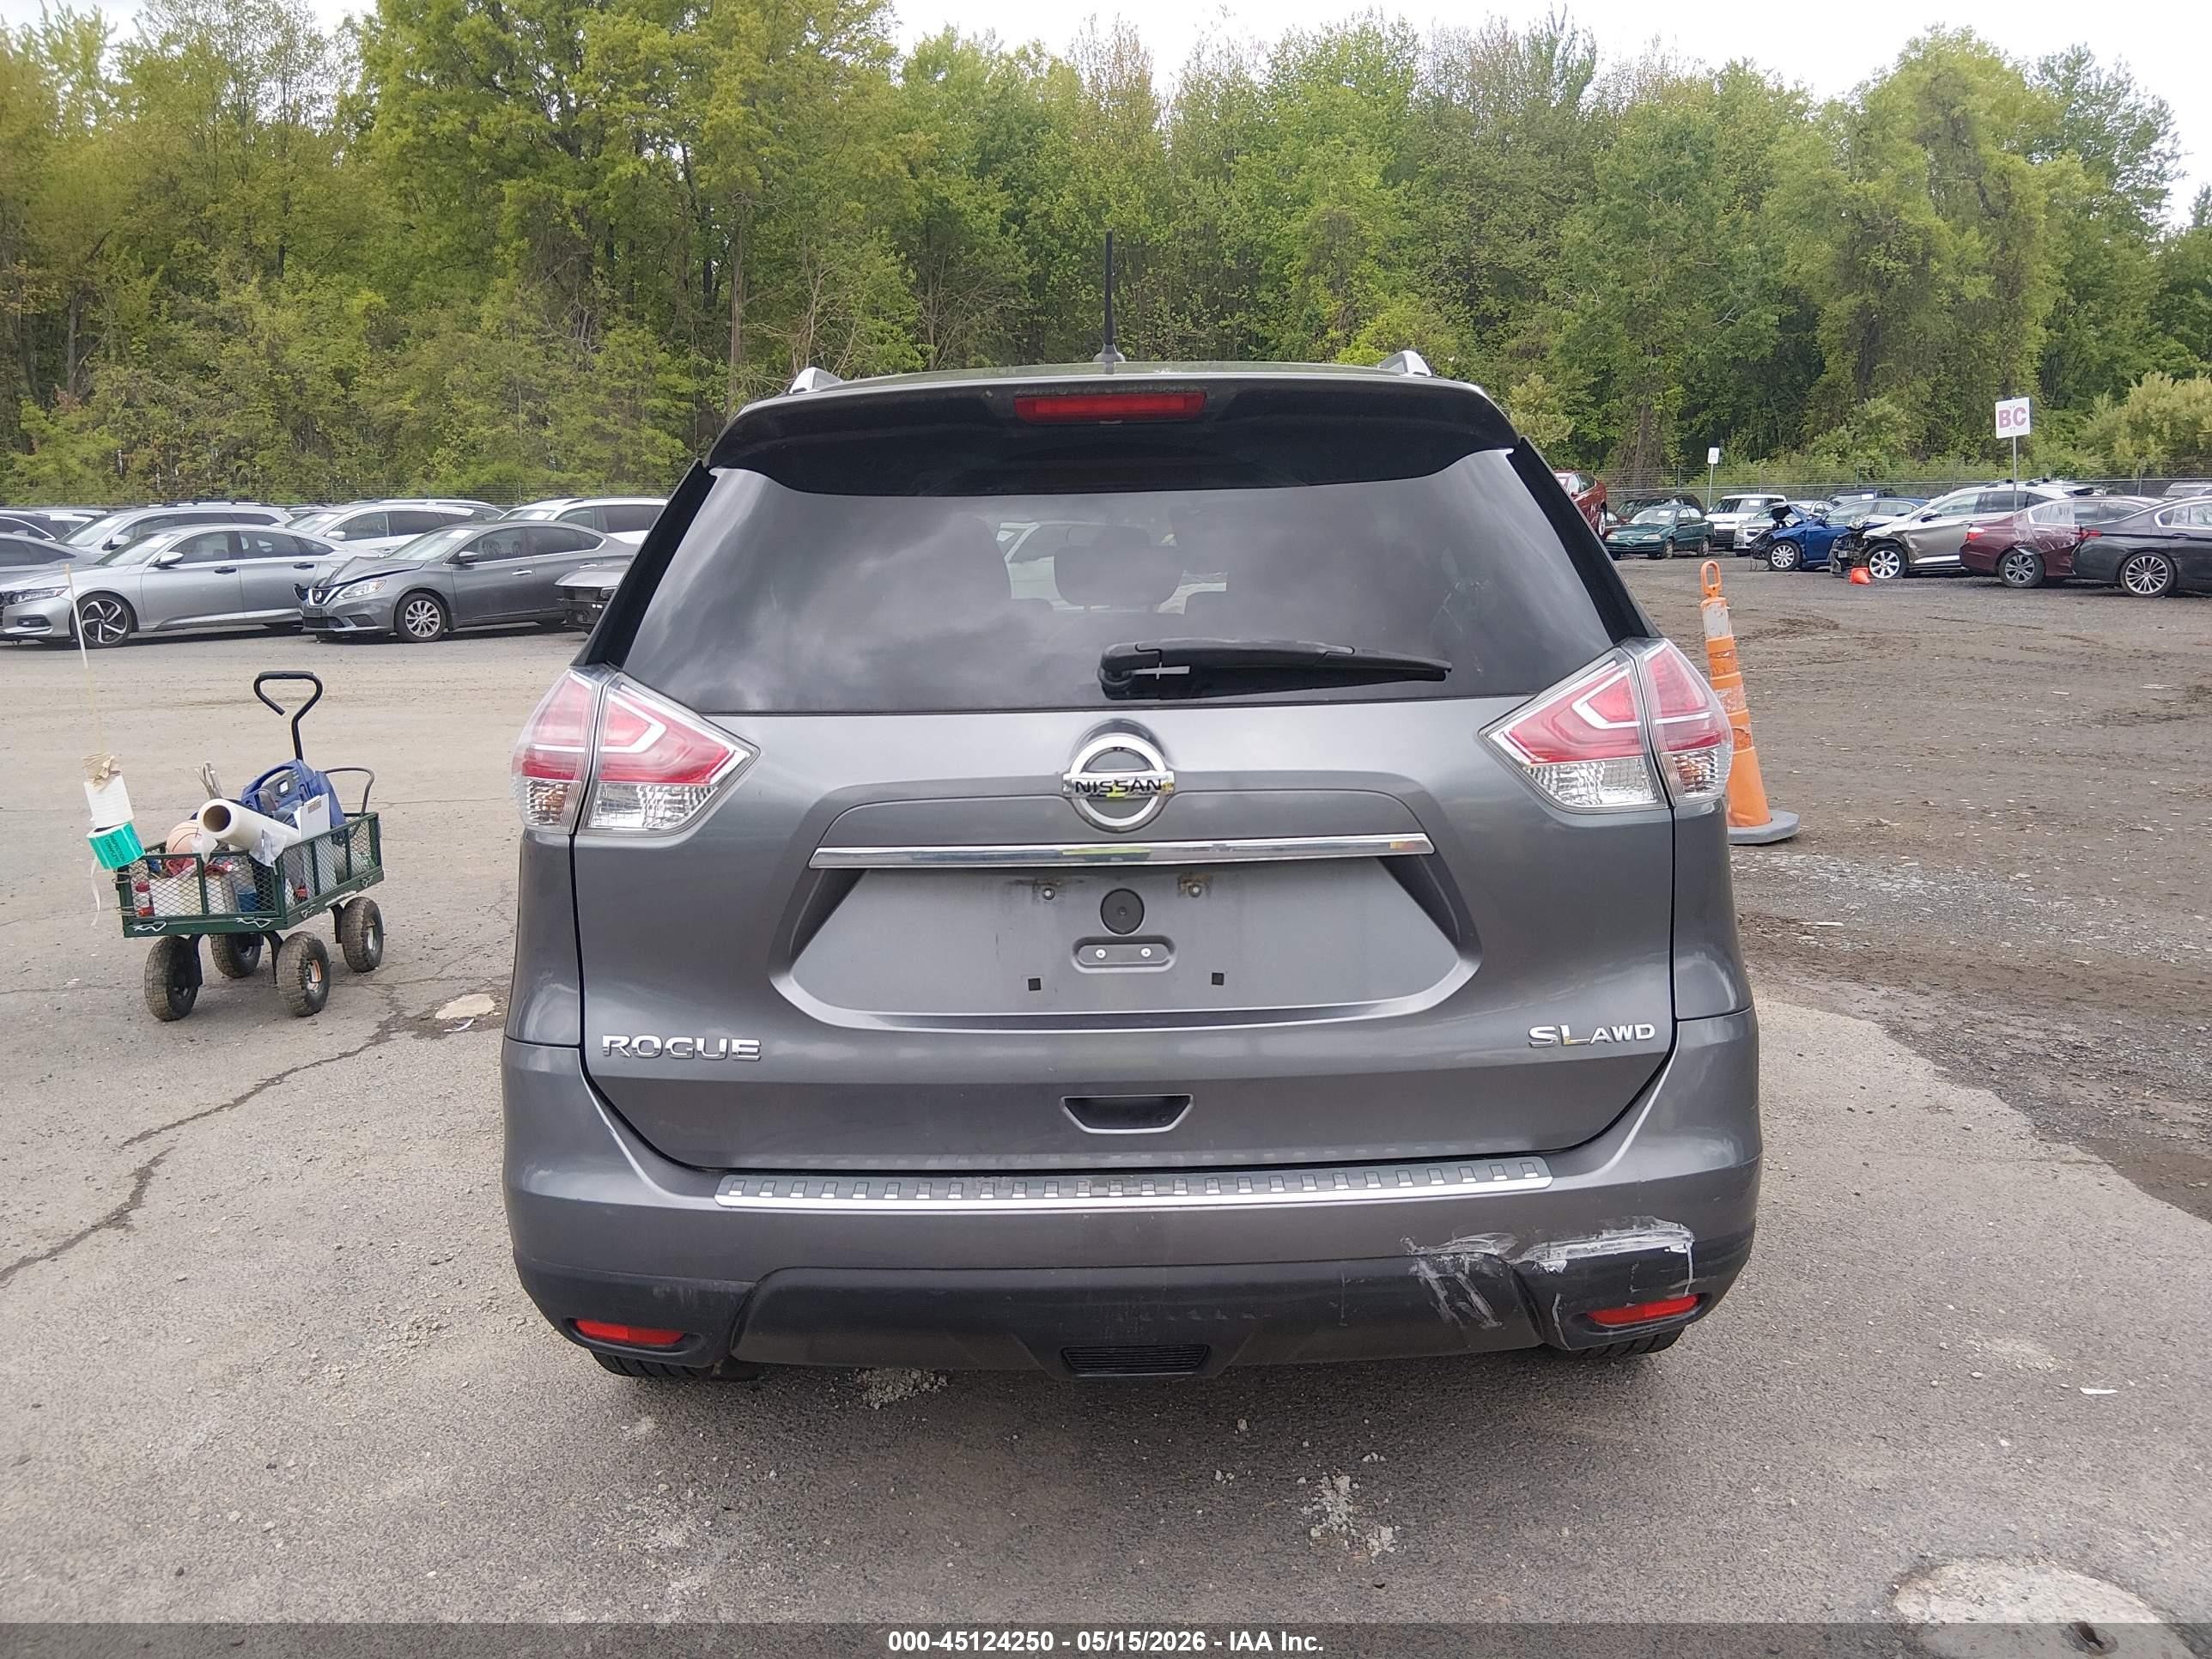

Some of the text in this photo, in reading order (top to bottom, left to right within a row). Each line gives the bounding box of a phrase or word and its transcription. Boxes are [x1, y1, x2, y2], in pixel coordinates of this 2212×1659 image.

[1998, 407, 2027, 428] BC
[1075, 777, 1162, 793] NISSAN
[104, 838, 120, 863] COMPLETE
[109, 835, 126, 862] INSPECTION
[602, 1035, 762, 1061] ROGUE
